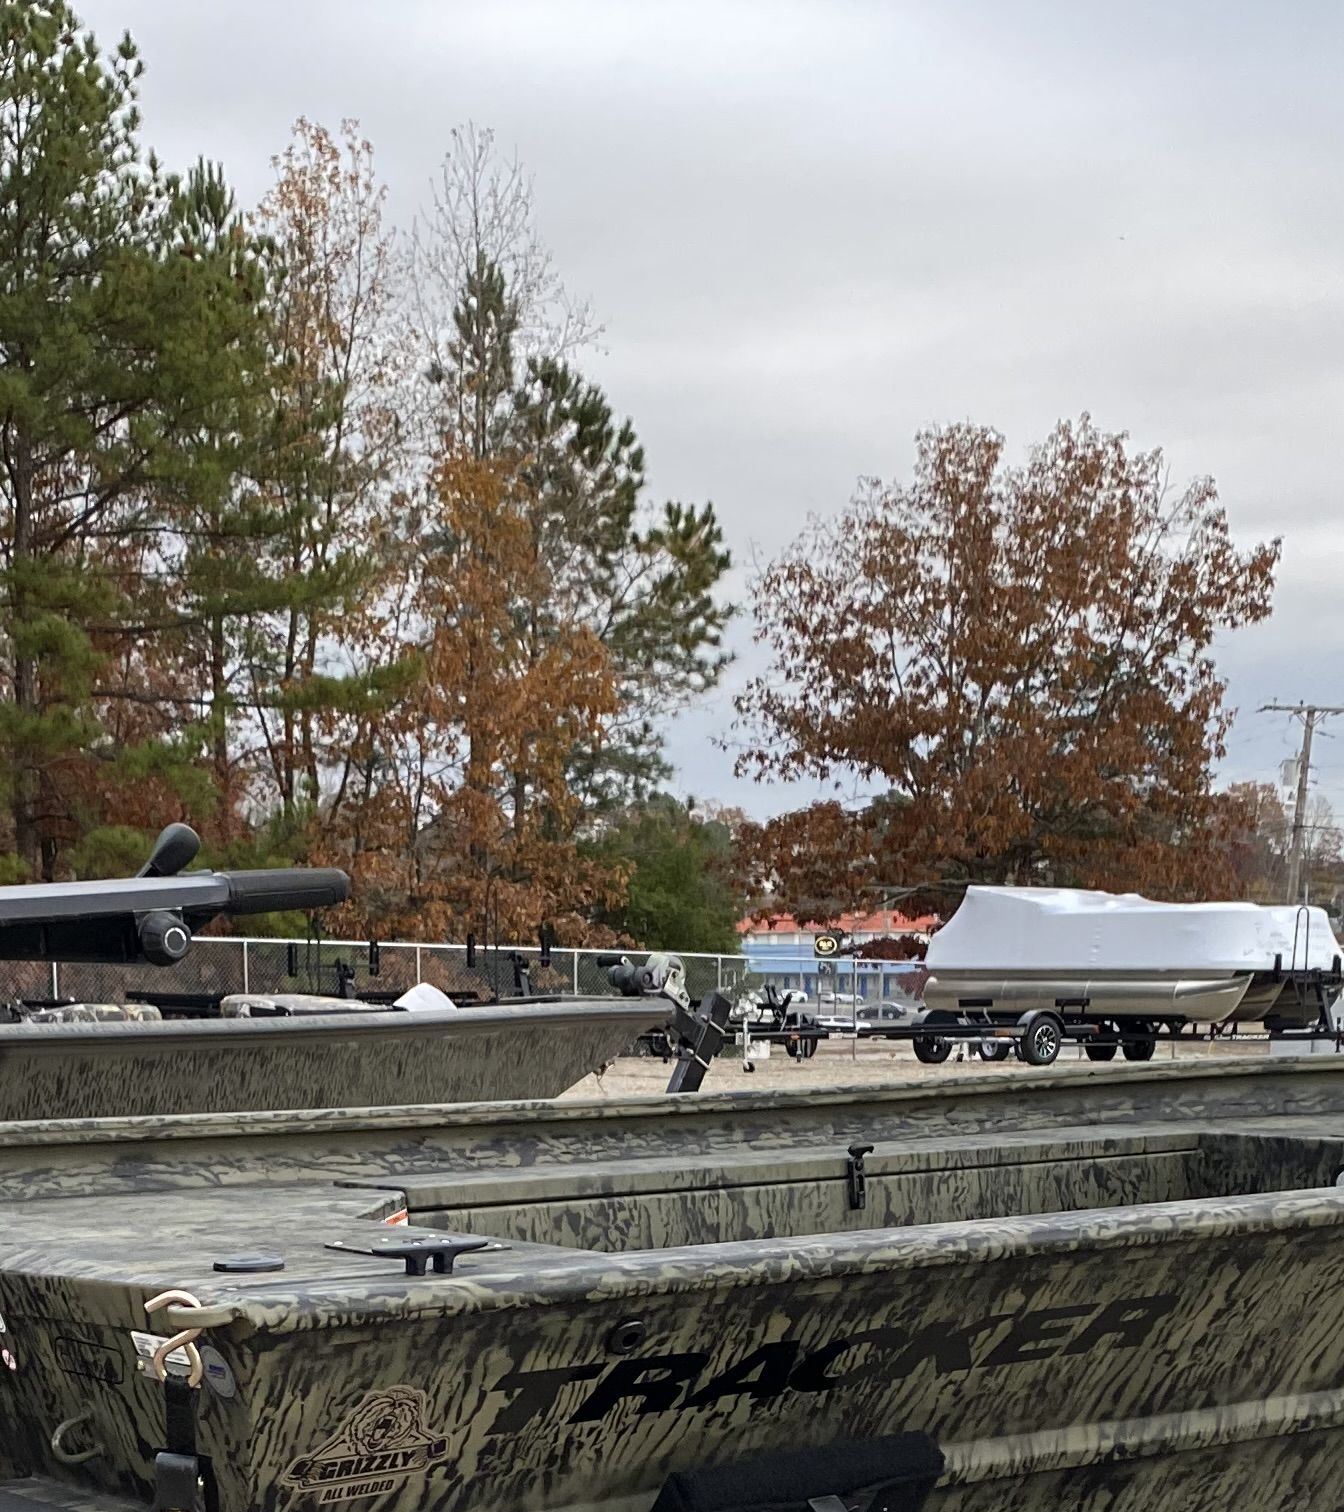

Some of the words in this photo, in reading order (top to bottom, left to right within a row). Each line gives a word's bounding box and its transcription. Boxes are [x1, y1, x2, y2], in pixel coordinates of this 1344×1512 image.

[484, 1294, 1178, 1437] TRACKER
[320, 1451, 416, 1480] GRIZZLY
[323, 1487, 343, 1501] ALL
[347, 1481, 394, 1497] WELDED
